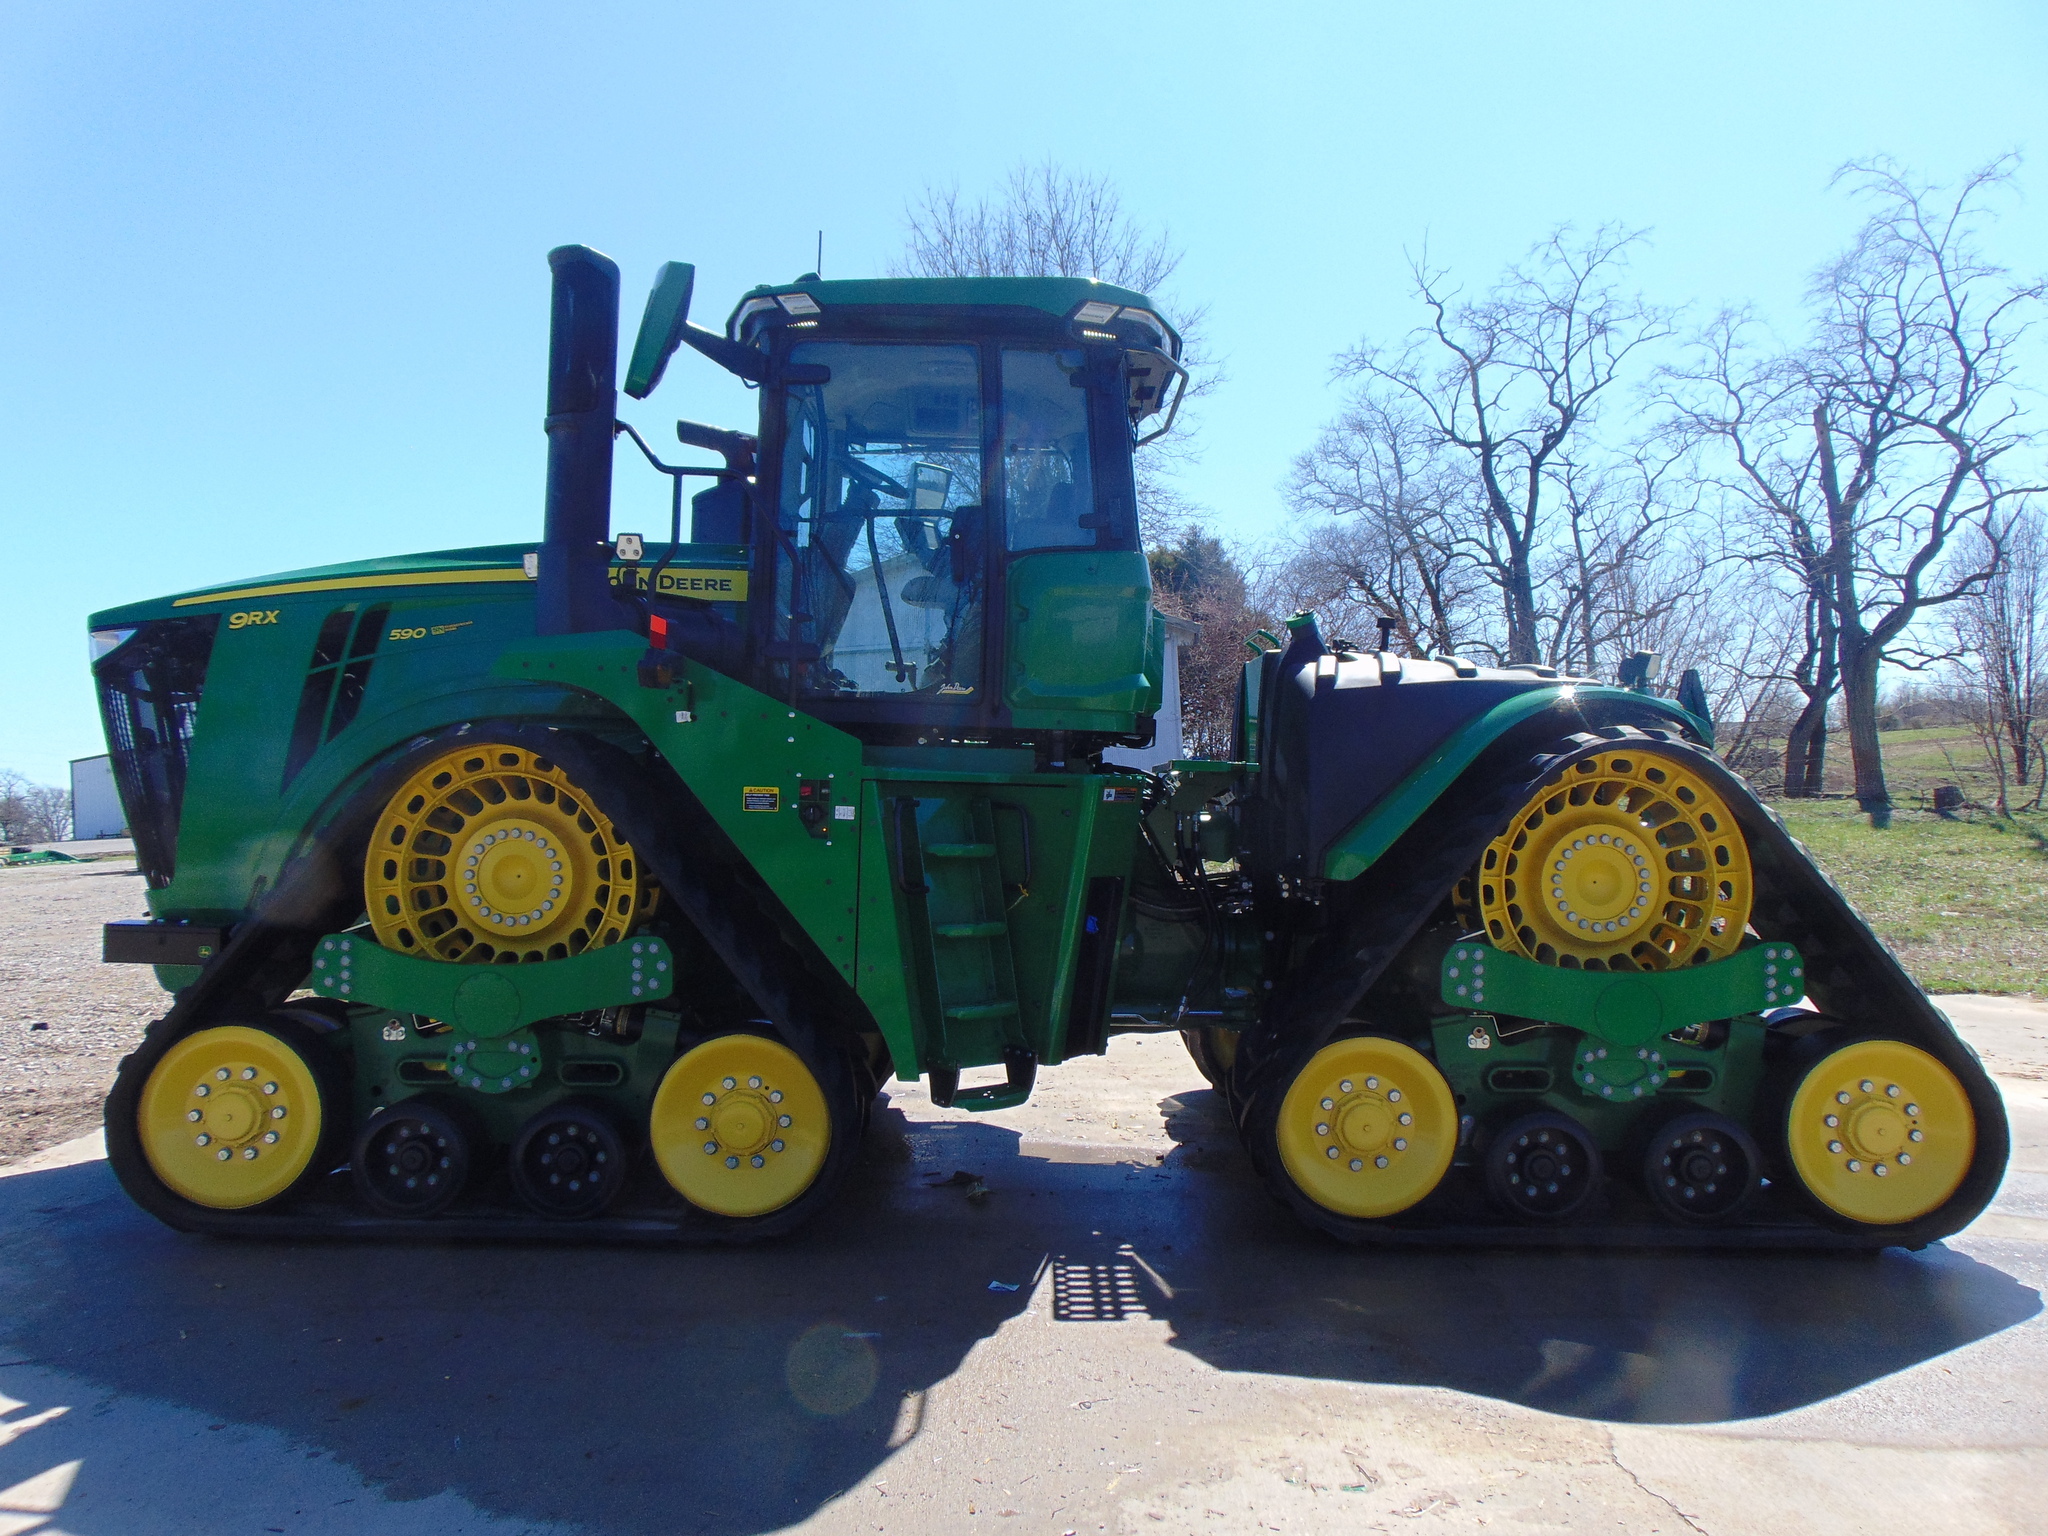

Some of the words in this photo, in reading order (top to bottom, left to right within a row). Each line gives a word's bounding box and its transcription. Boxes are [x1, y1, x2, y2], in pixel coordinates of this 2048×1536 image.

[659, 574, 733, 592] DEERE
[228, 609, 281, 630] 9RX
[388, 627, 427, 641] 590
